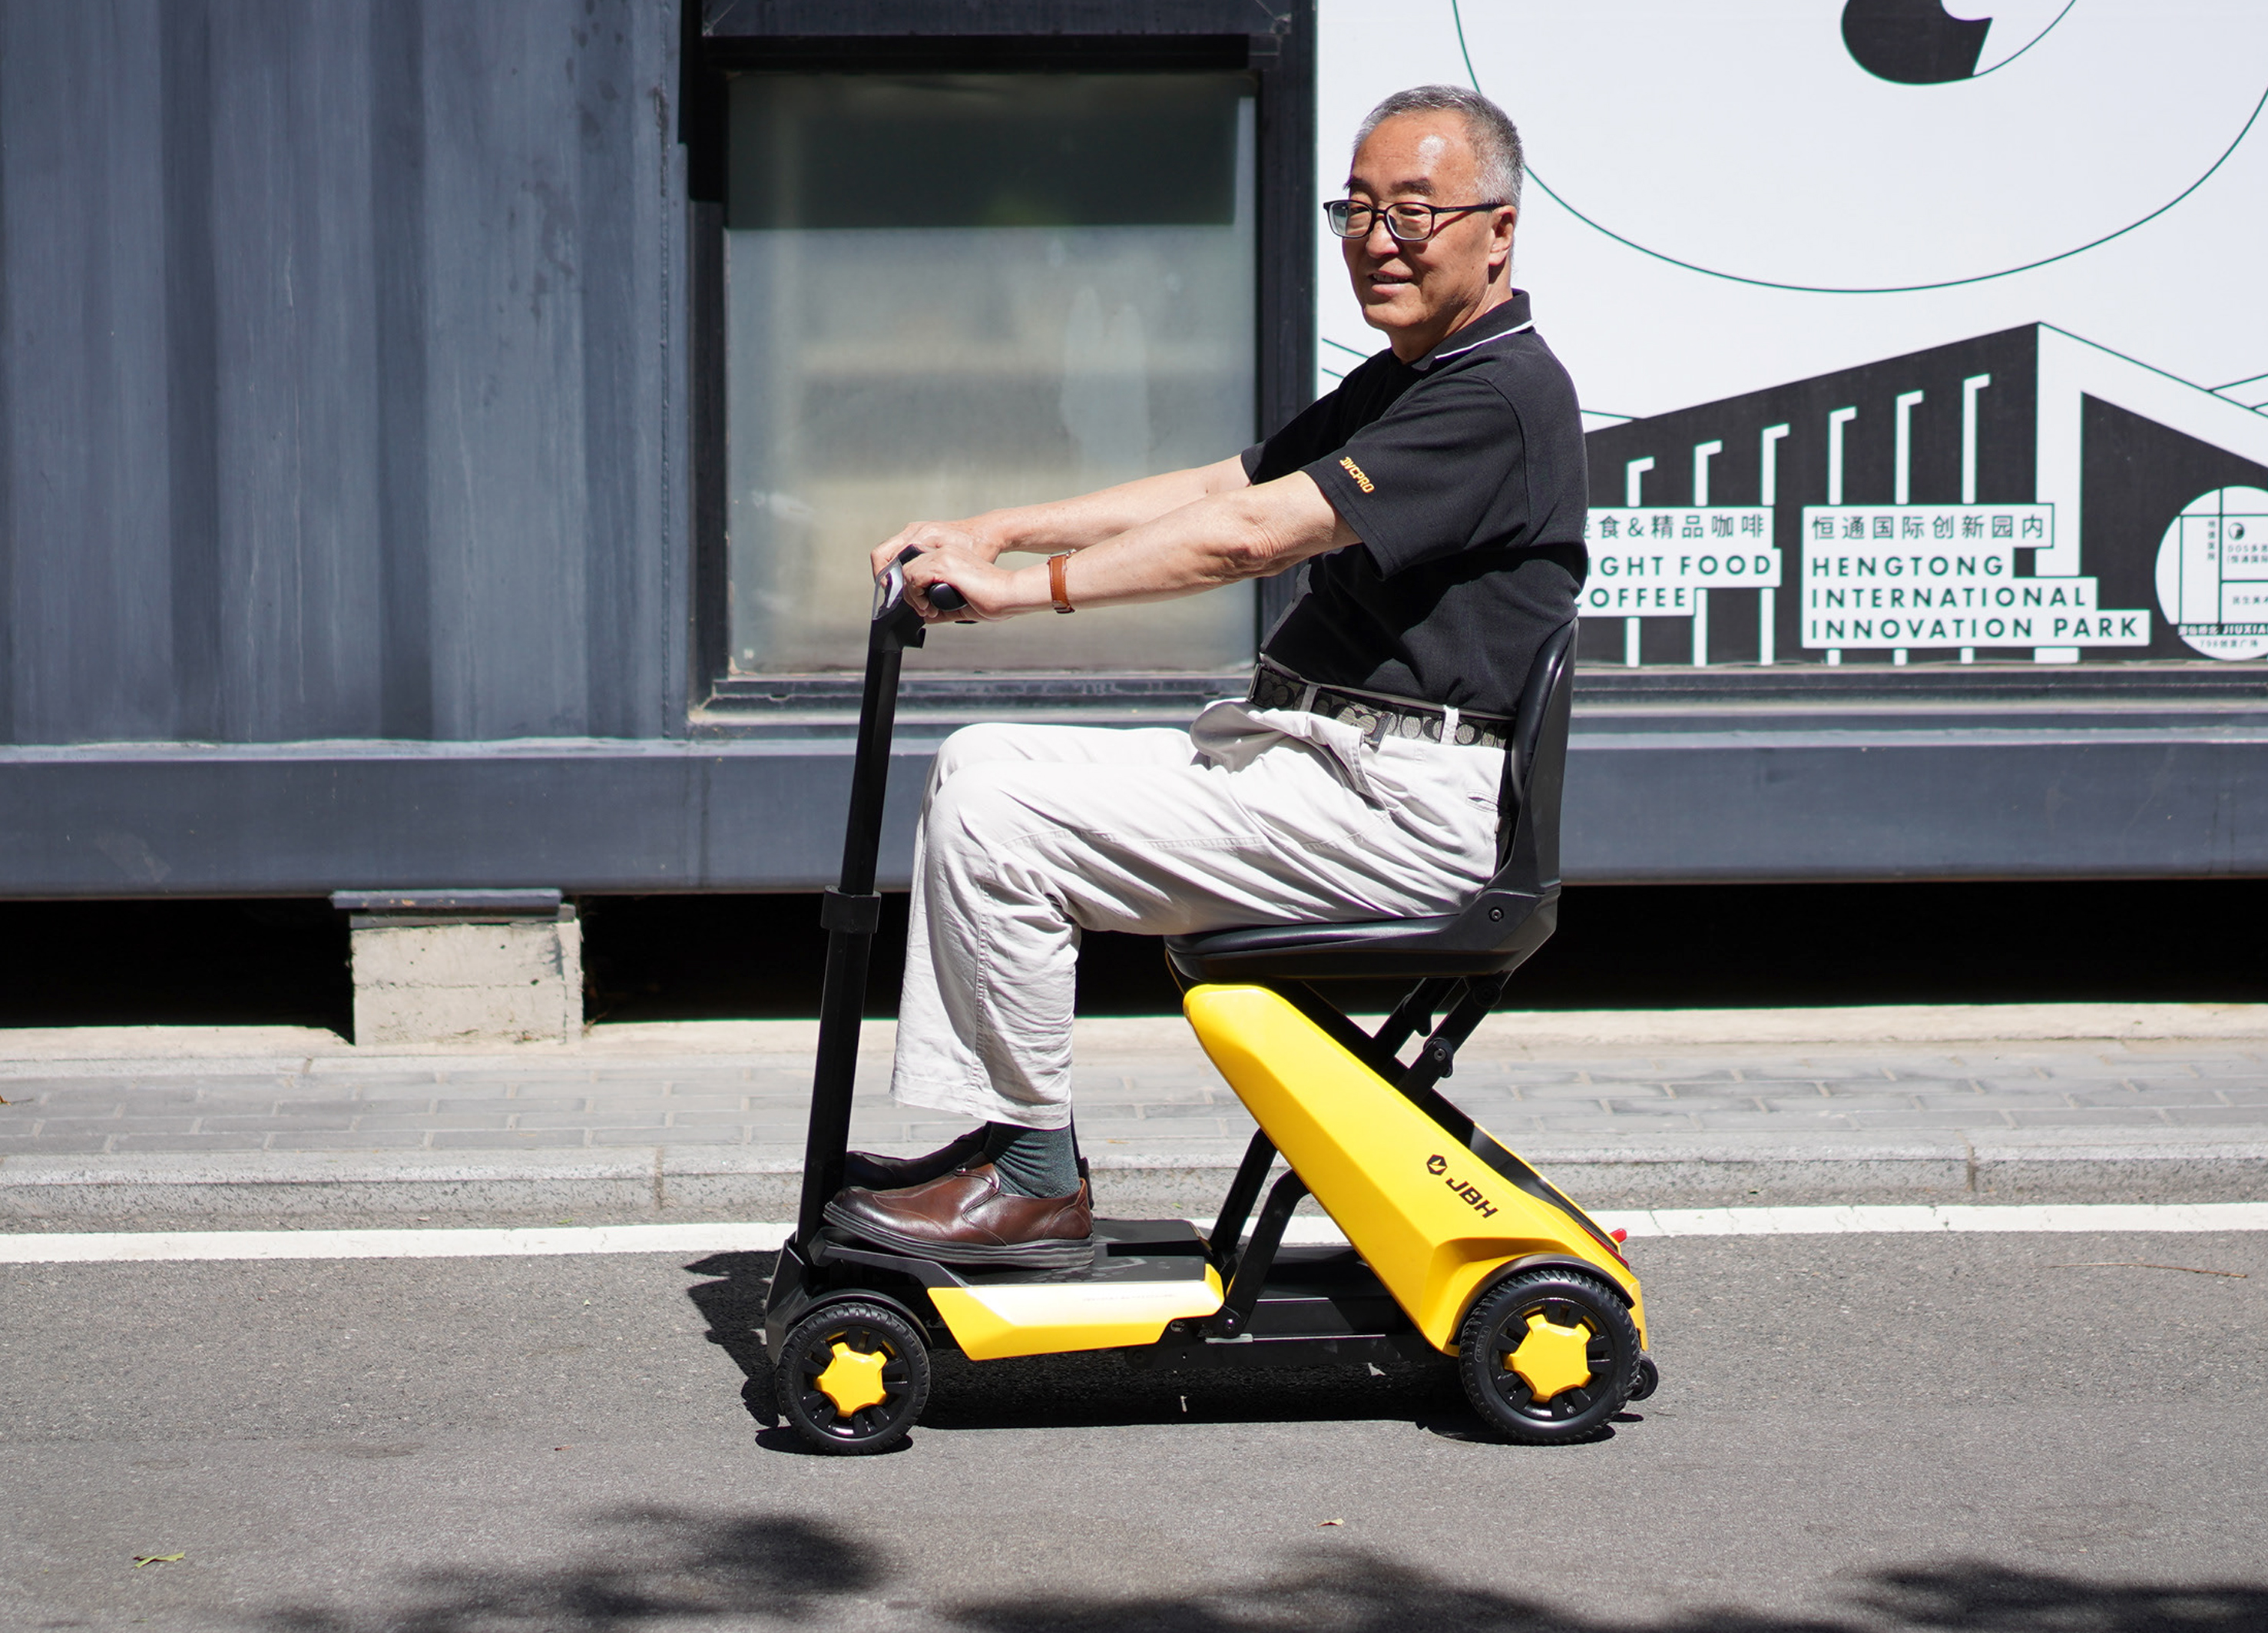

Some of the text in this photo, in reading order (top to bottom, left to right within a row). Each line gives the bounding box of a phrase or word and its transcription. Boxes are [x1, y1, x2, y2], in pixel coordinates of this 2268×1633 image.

[1812, 515, 2044, 539] 恒通国际创新园内
[1588, 555, 1771, 577] IGHT FOOD
[1812, 556, 2003, 577] HENGTONG
[1576, 587, 1686, 608] OFFEE
[1812, 587, 2086, 608] INTERNATIONAL
[1812, 617, 2137, 639] INNOVATION PARK
[1445, 1178, 1498, 1218] JBH
